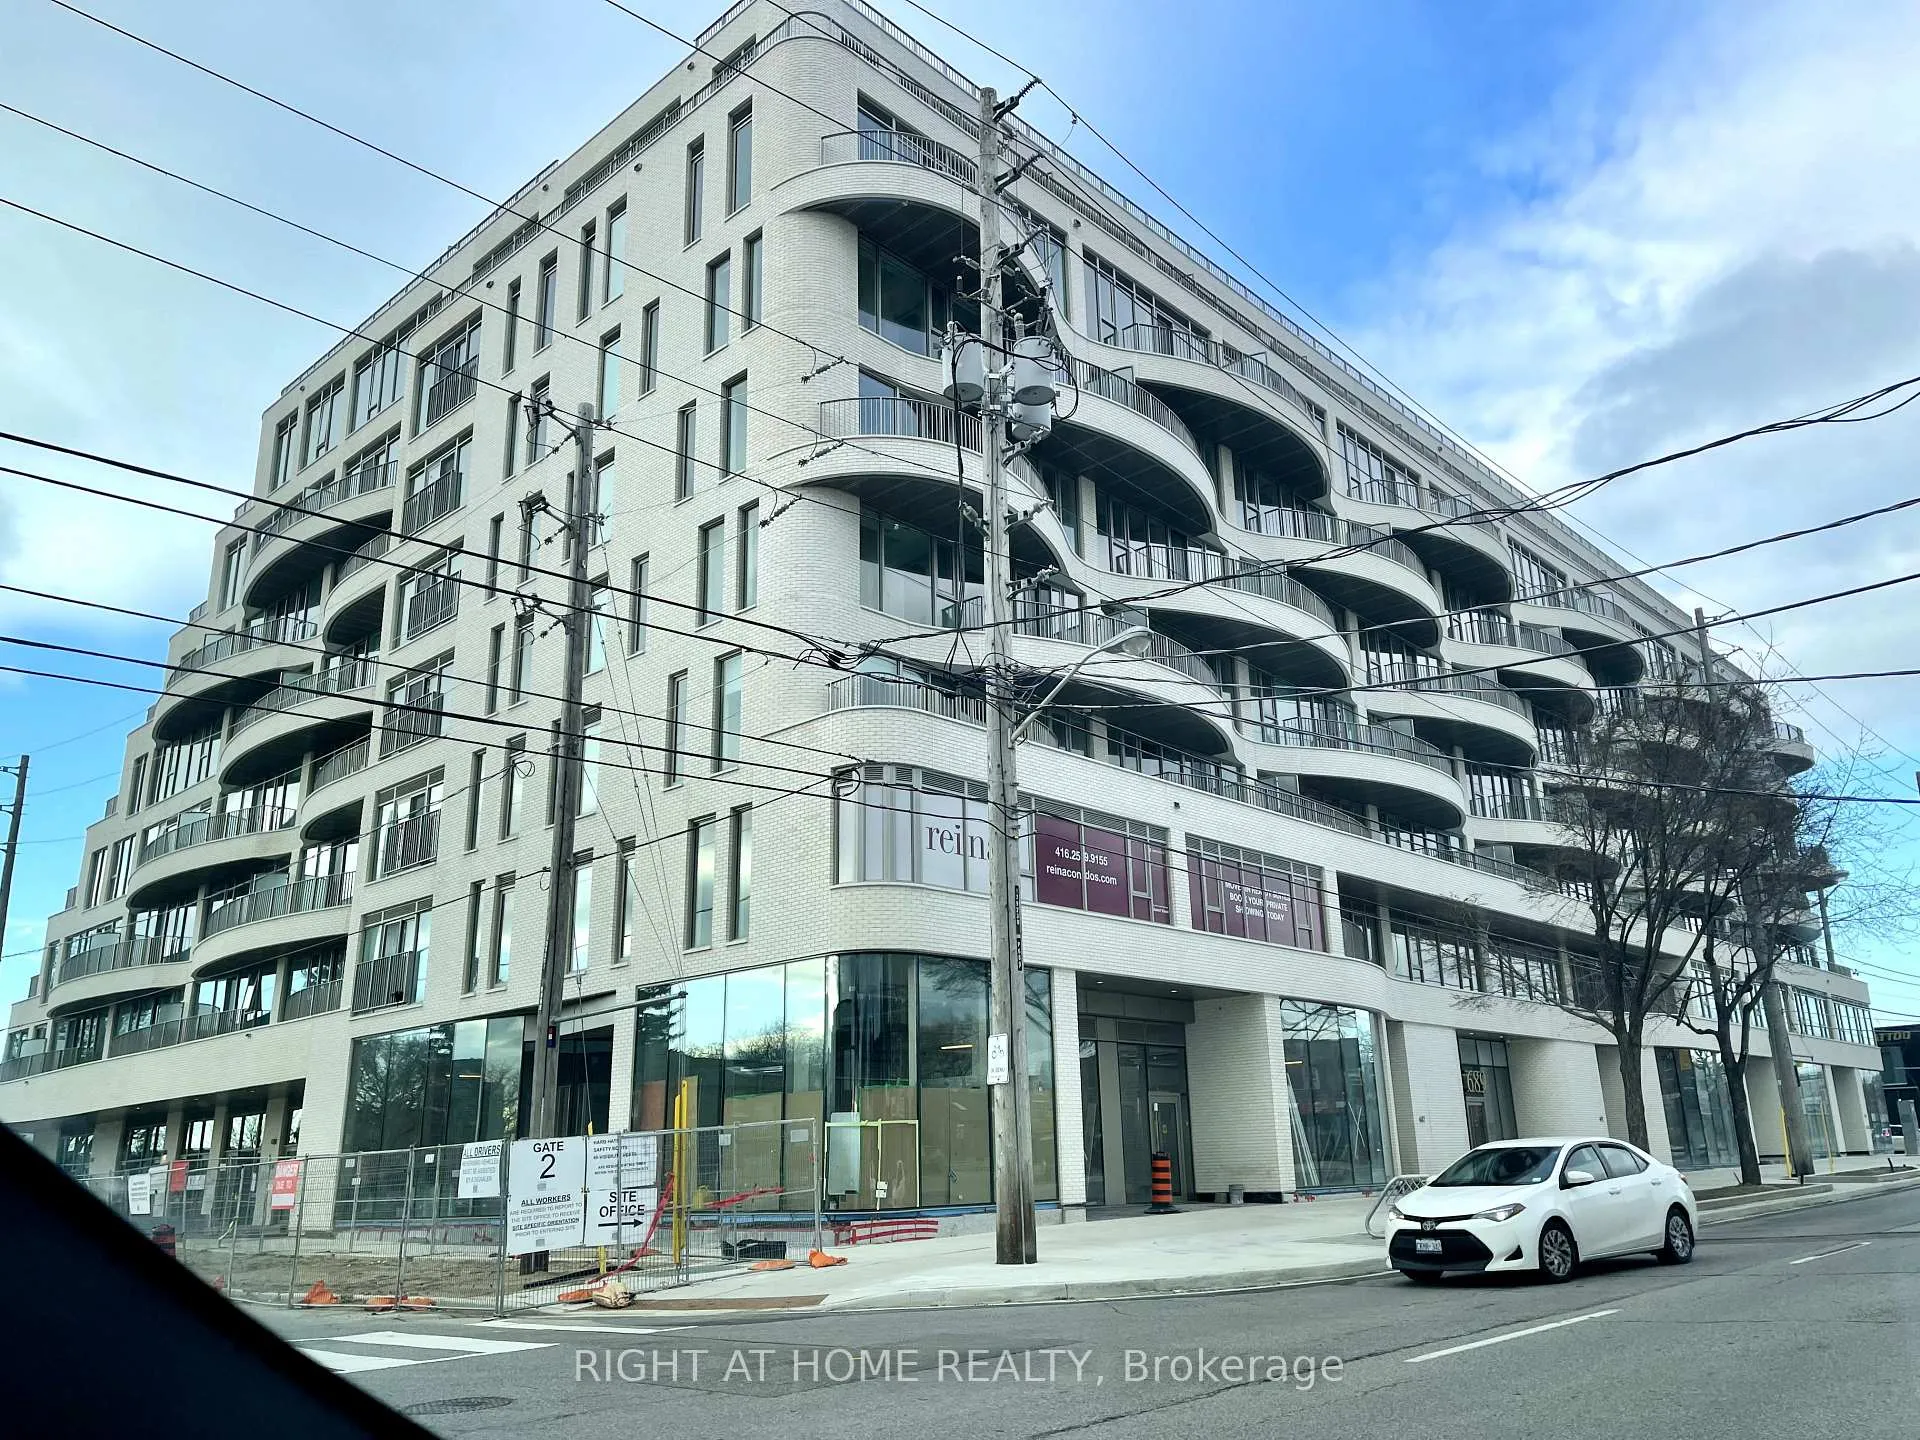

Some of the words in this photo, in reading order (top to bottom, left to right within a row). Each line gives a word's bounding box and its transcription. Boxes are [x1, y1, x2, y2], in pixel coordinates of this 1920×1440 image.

[924, 824, 990, 860] rein
[1055, 847, 1108, 866] 416.259.9155
[1046, 865, 1117, 885] reinacondos.com
[1229, 893, 1248, 903] BOOK
[1249, 896, 1264, 906] YOUR
[1266, 900, 1288, 911] PRIVATE
[1235, 905, 1265, 918] SHOWING
[1267, 911, 1285, 920] TODAY
[463, 1149, 473, 1157] ALL
[475, 1144, 501, 1157] DRIVERS
[533, 1141, 564, 1153] GATE
[540, 1153, 556, 1179] 2
[536, 1194, 571, 1204] WORKERS
[609, 1190, 637, 1203] STE
[600, 1204, 645, 1218] OFFICE
